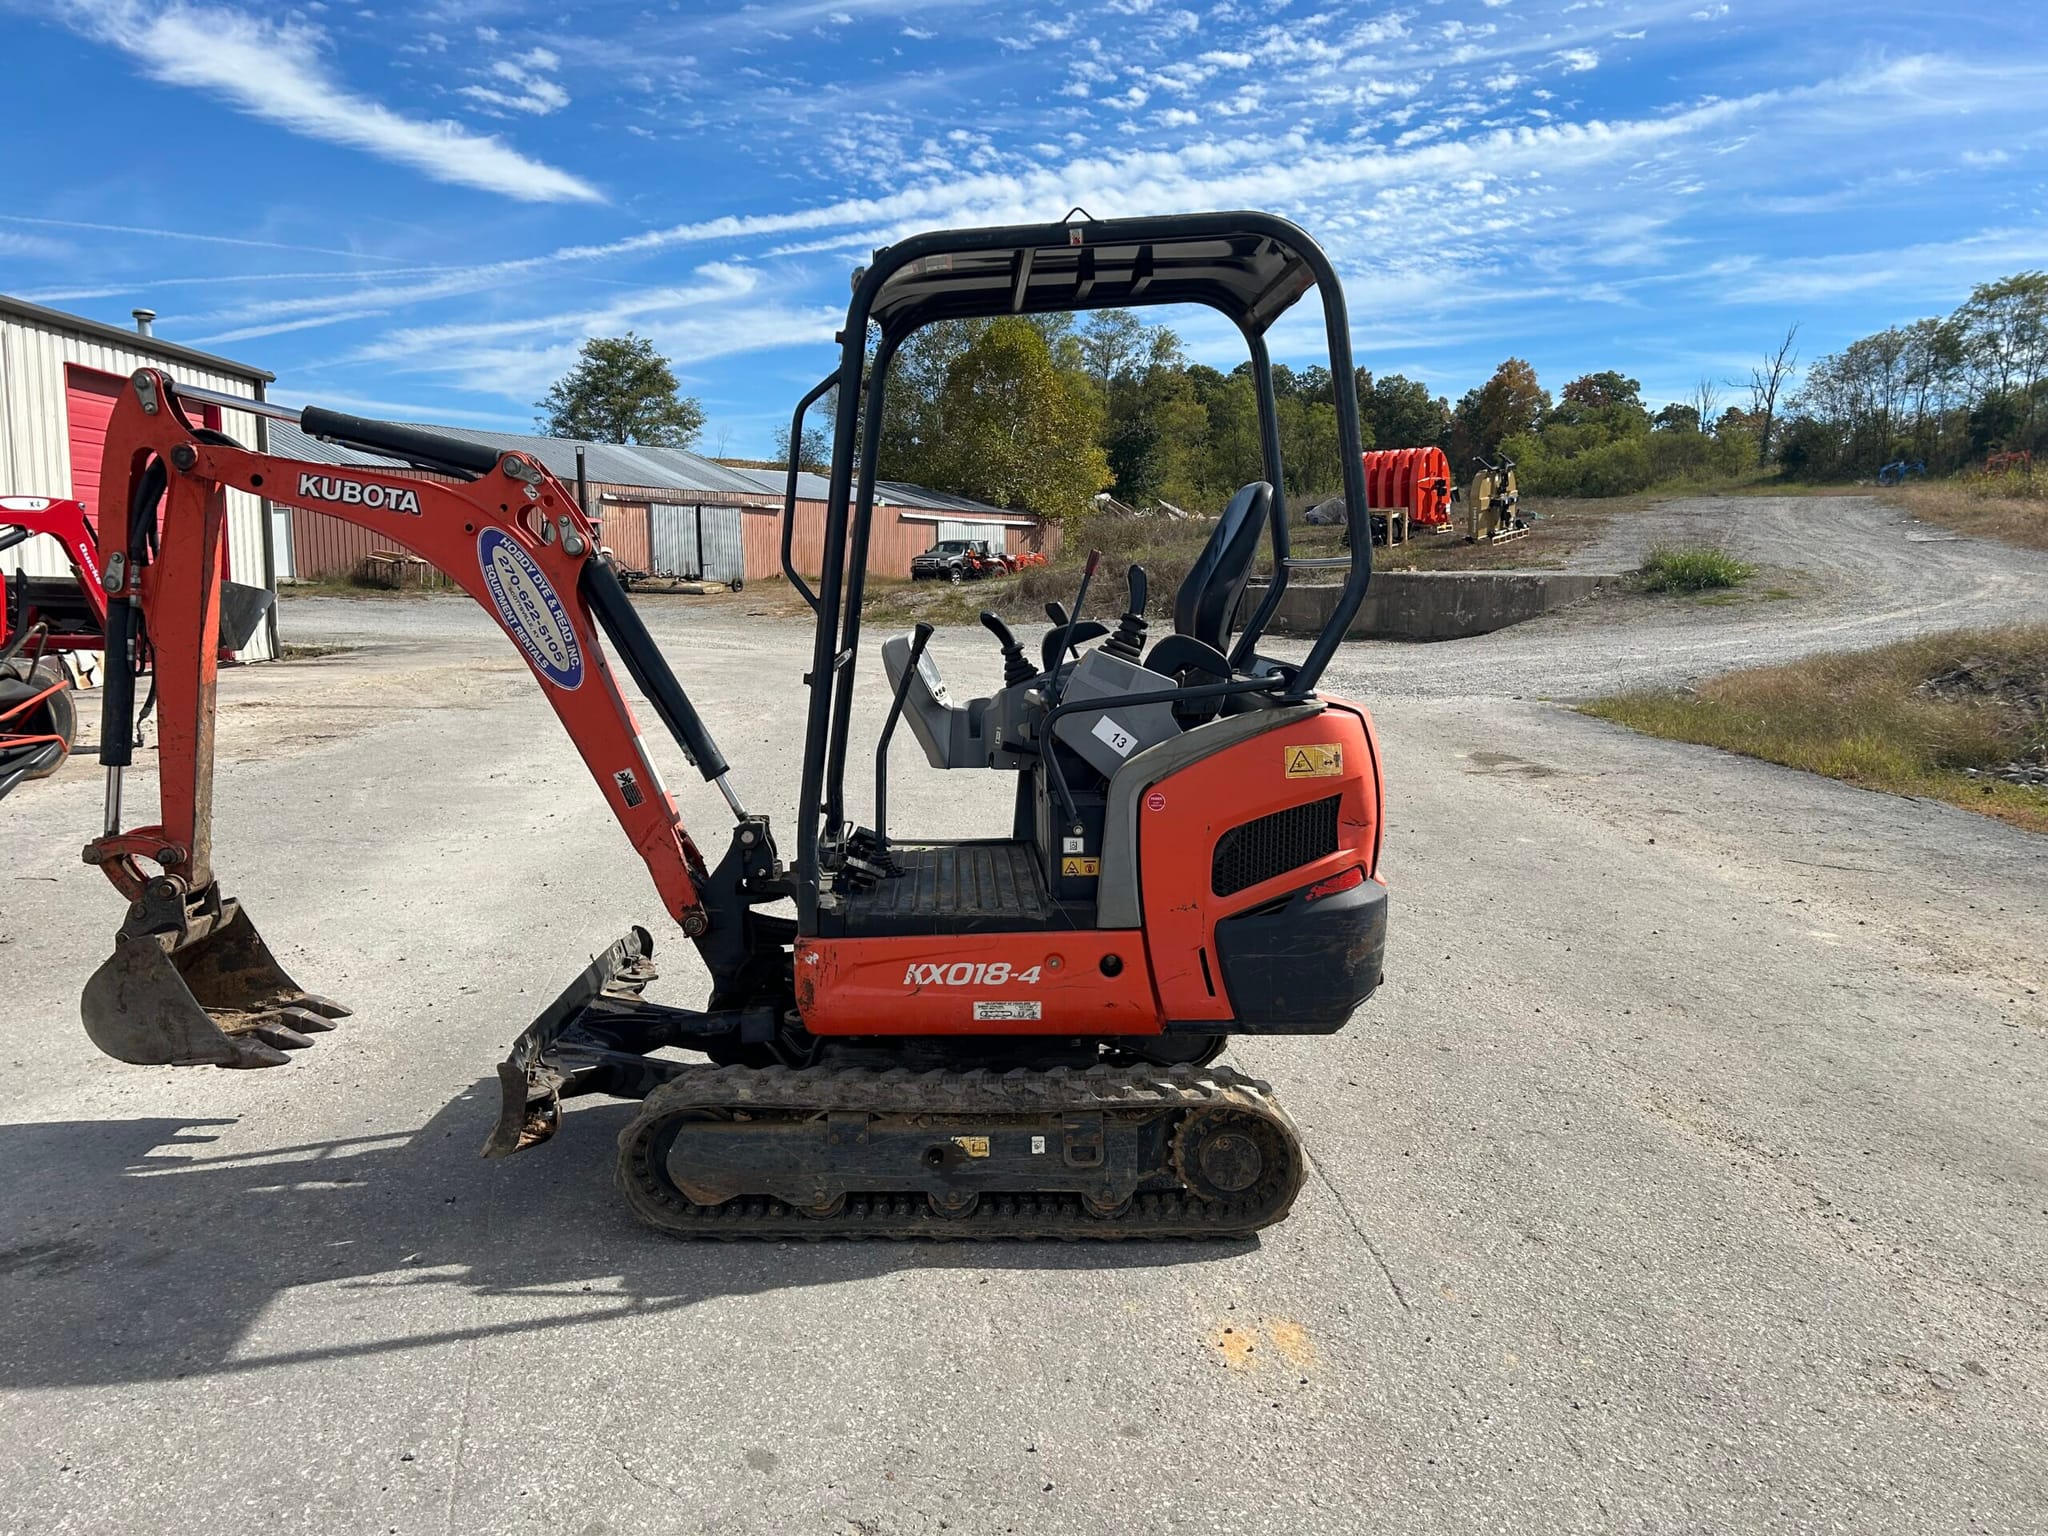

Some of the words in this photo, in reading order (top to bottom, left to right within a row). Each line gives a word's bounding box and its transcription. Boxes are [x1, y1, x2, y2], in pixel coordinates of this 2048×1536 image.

[298, 473, 420, 514] KUBOTA
[484, 564, 518, 626] EQUIPMENT
[513, 625, 550, 669] RENTALS
[497, 555, 566, 663] 270-622-5105
[500, 537, 536, 578] HOBDY
[532, 573, 551, 599] DYE
[547, 598, 559, 610] &
[553, 608, 573, 643] READ
[566, 642, 580, 670] INC.
[1111, 732, 1128, 749] 13
[903, 961, 1042, 986] KX018-4
